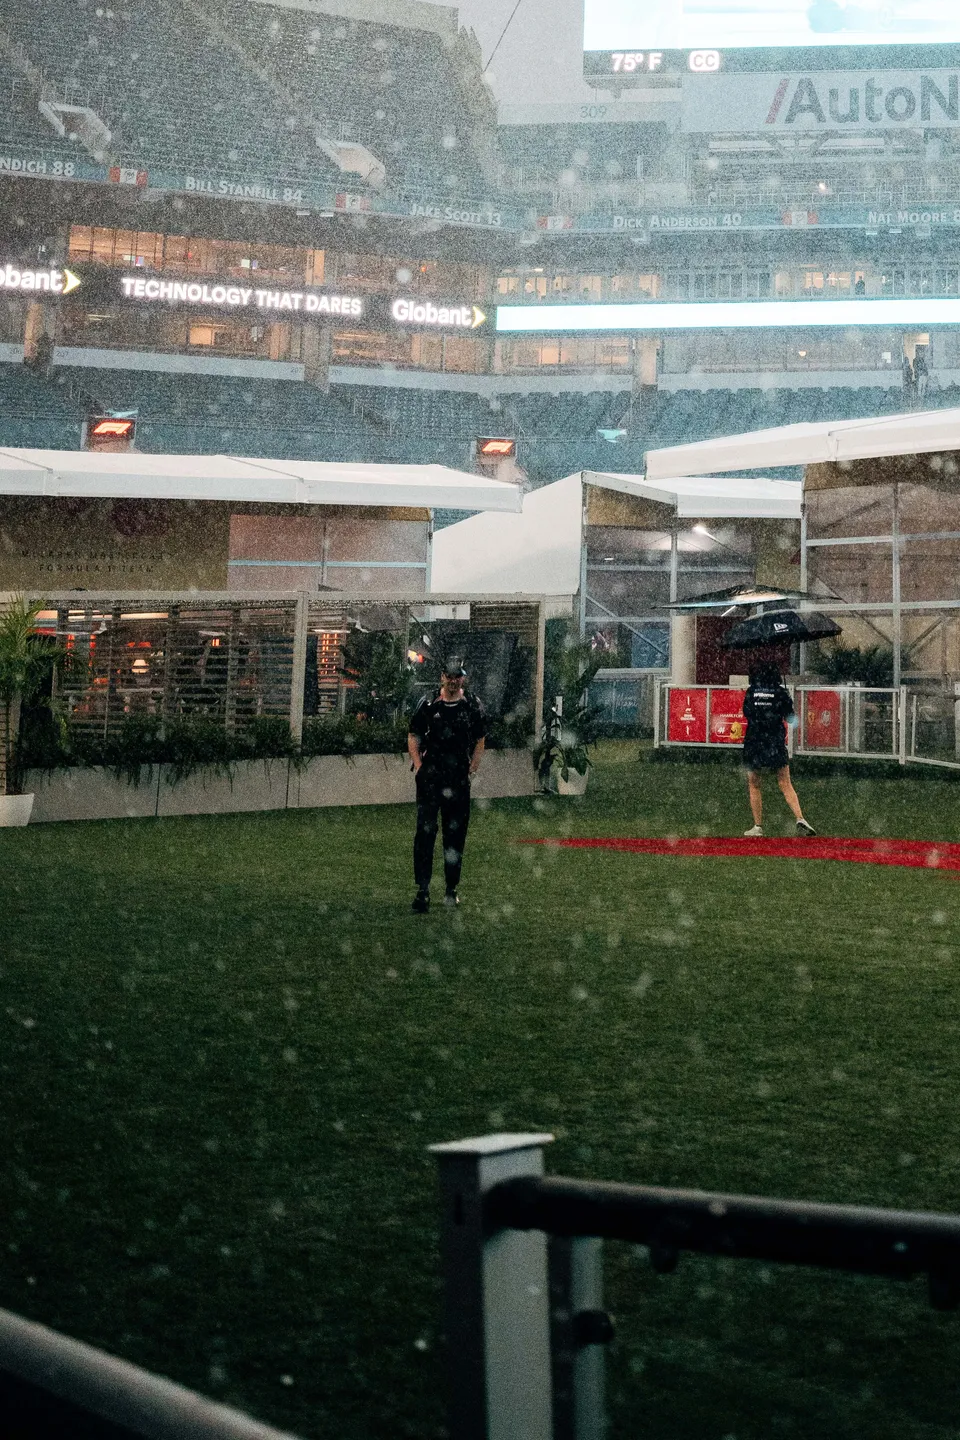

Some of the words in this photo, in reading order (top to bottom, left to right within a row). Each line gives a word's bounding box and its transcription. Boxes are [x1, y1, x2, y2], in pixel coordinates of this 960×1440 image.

[649, 52, 663, 70] F
[693, 54, 716, 69] CC
[580, 105, 607, 119] 309
[52, 160, 75, 177] 88
[487, 210, 502, 225] 13
[722, 213, 742, 227] 40
[122, 276, 251, 306] TECHNOLOGY
[256, 289, 303, 310] THAT
[306, 294, 362, 317] DARES
[392, 298, 472, 327] Globant
